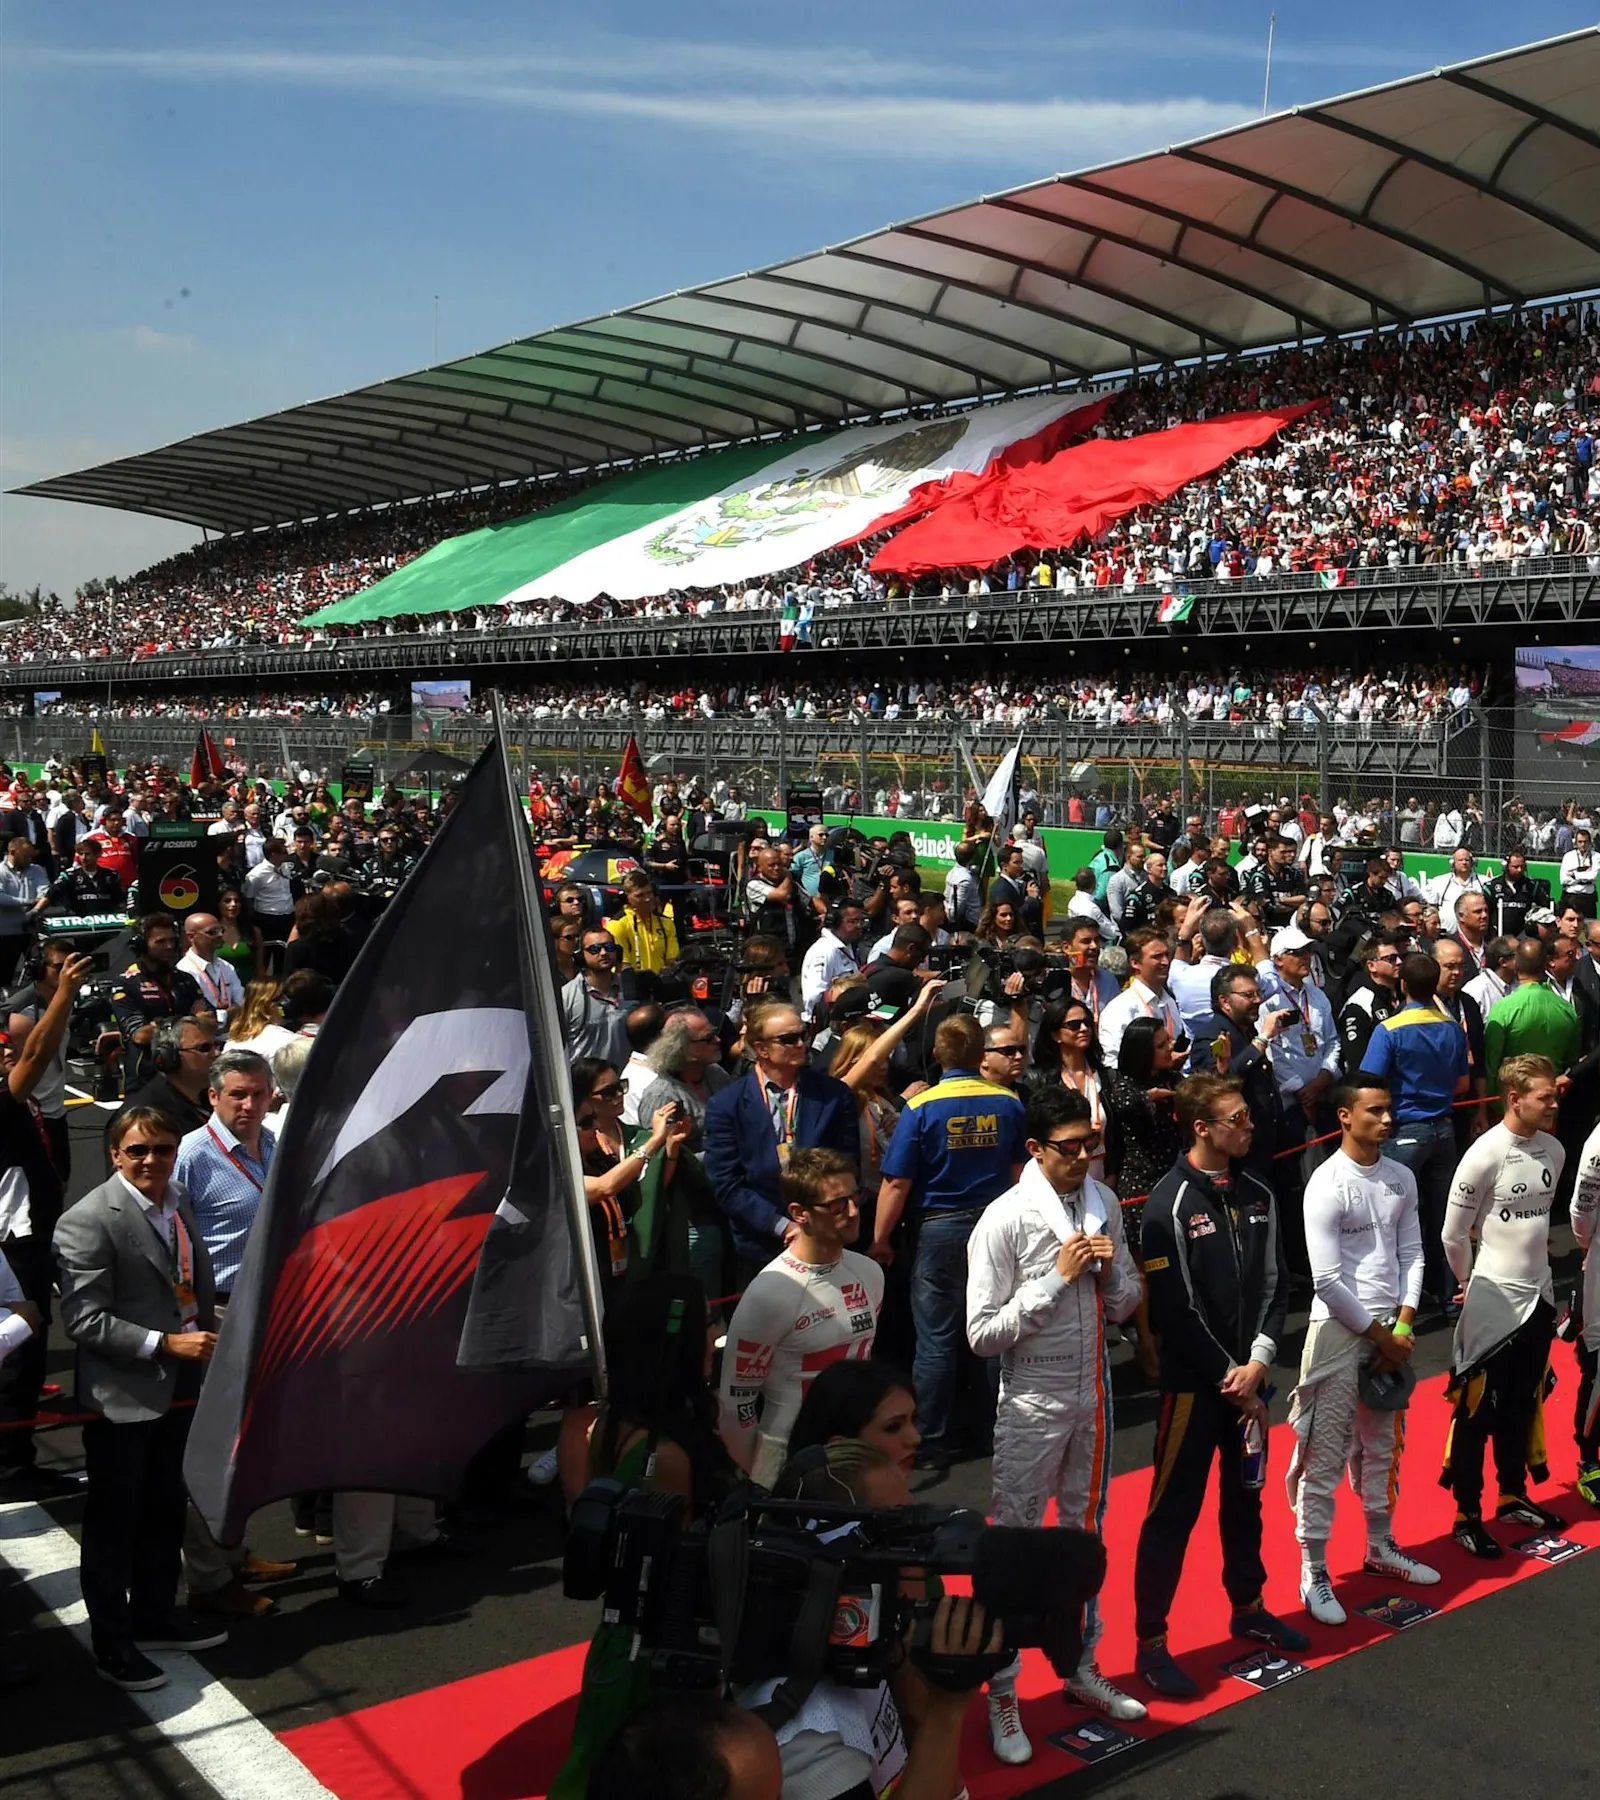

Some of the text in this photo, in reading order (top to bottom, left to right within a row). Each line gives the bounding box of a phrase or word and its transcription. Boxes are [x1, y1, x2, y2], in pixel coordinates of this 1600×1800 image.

[159, 863, 199, 910] 6
[946, 1114, 997, 1134] CAM
[947, 1135, 997, 1147] SECURITY
[1034, 1354, 1073, 1363] ESTEBAN
